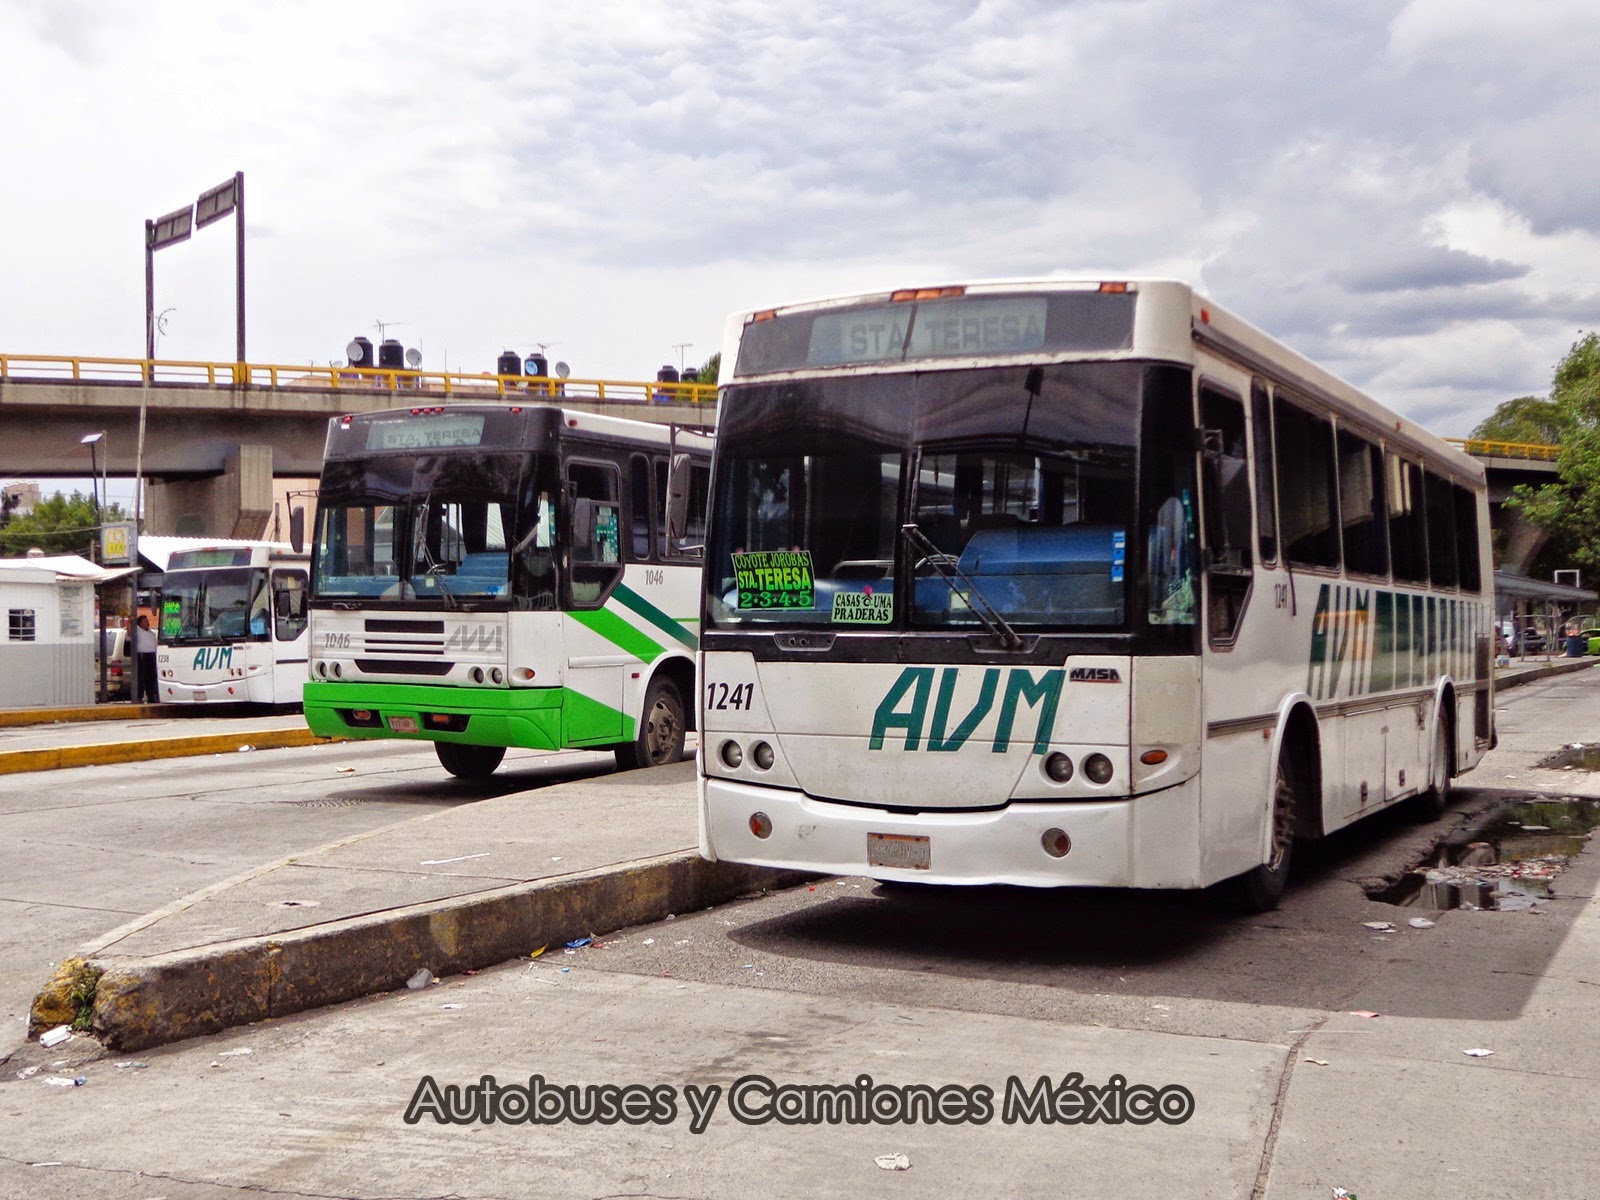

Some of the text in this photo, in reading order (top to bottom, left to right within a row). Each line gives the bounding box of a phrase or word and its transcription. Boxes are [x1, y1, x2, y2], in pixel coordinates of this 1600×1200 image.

[925, 315, 1044, 350] TERESA
[735, 552, 810, 569] COYOTE JOROBAS
[645, 569, 664, 585] 1046
[755, 567, 812, 591] TERESA
[835, 594, 861, 607] CASAS
[833, 608, 889, 621] PRADERAS
[324, 633, 350, 649] 1046
[193, 647, 233, 670] AVM
[1070, 668, 1120, 681] MASA
[706, 682, 754, 711] 1241
[868, 667, 1067, 755] AVM
